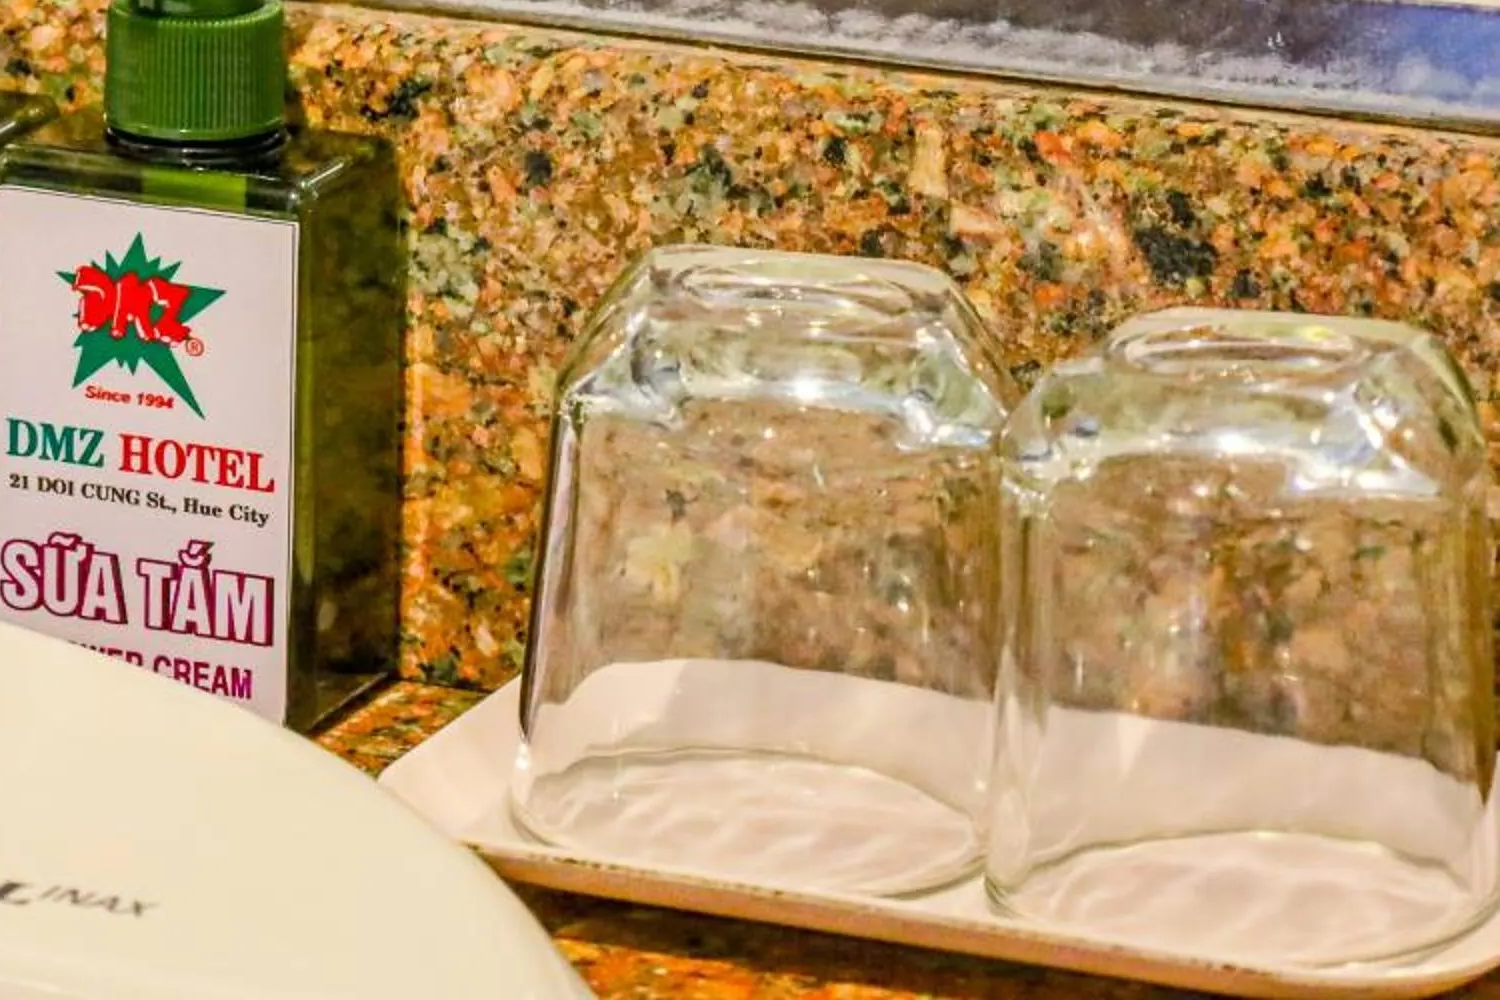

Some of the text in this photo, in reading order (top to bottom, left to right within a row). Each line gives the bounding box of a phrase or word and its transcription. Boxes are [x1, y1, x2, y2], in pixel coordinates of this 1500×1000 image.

[84, 385, 174, 409] Since 1994
[6, 417, 275, 493] DMZ HOTEL
[9, 473, 269, 527] 21 DOI CUNG St., Hue City
[0, 532, 275, 648] SỮA TẮM
